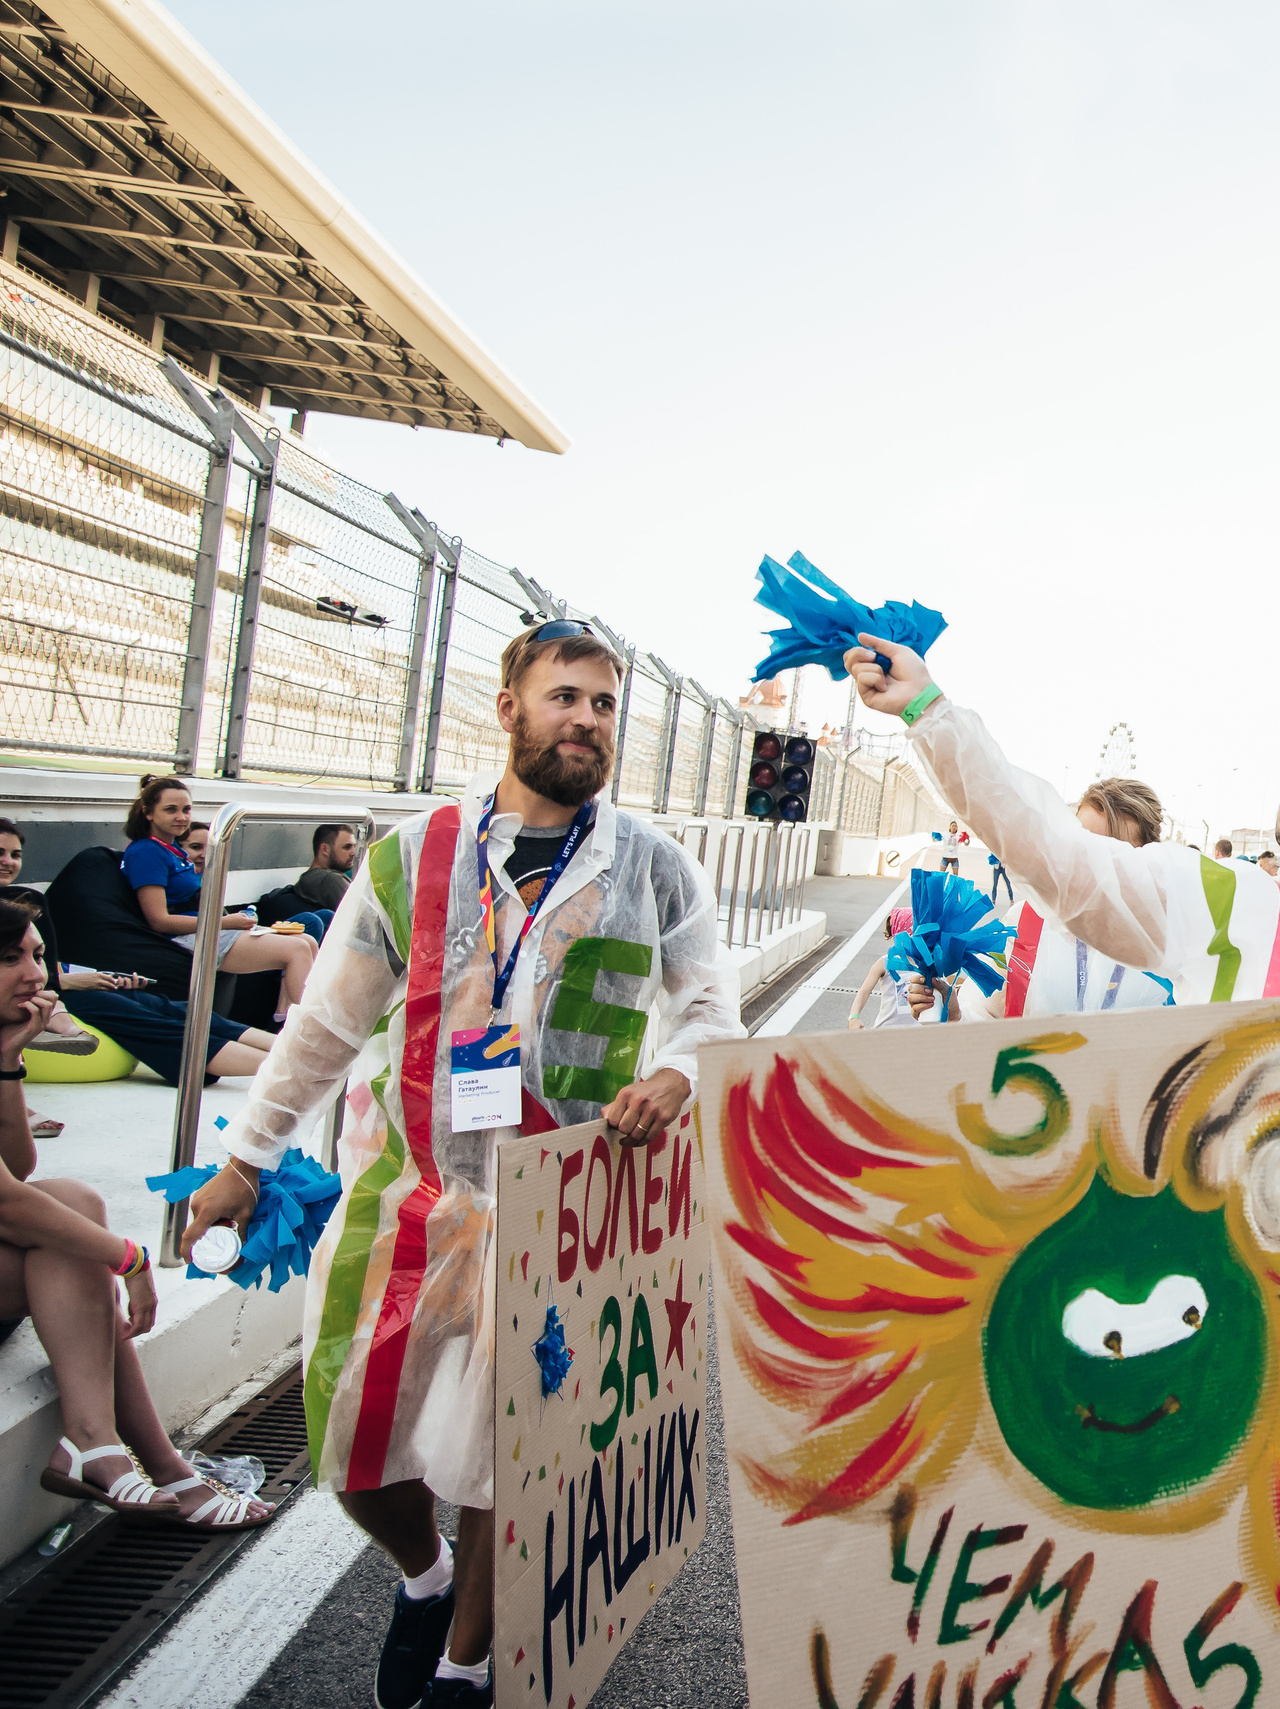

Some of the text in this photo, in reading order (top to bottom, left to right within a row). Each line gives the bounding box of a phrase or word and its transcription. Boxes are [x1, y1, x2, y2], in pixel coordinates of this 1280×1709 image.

[562, 825, 581, 858] LET'S PLAY!
[486, 1114, 502, 1122] CON
[557, 1111, 693, 1284] БОЛЕЙ
[589, 1293, 659, 1453] ЗА
[543, 1401, 700, 1708] НАШИХ
[889, 1484, 1095, 1661] ЧЕМ
